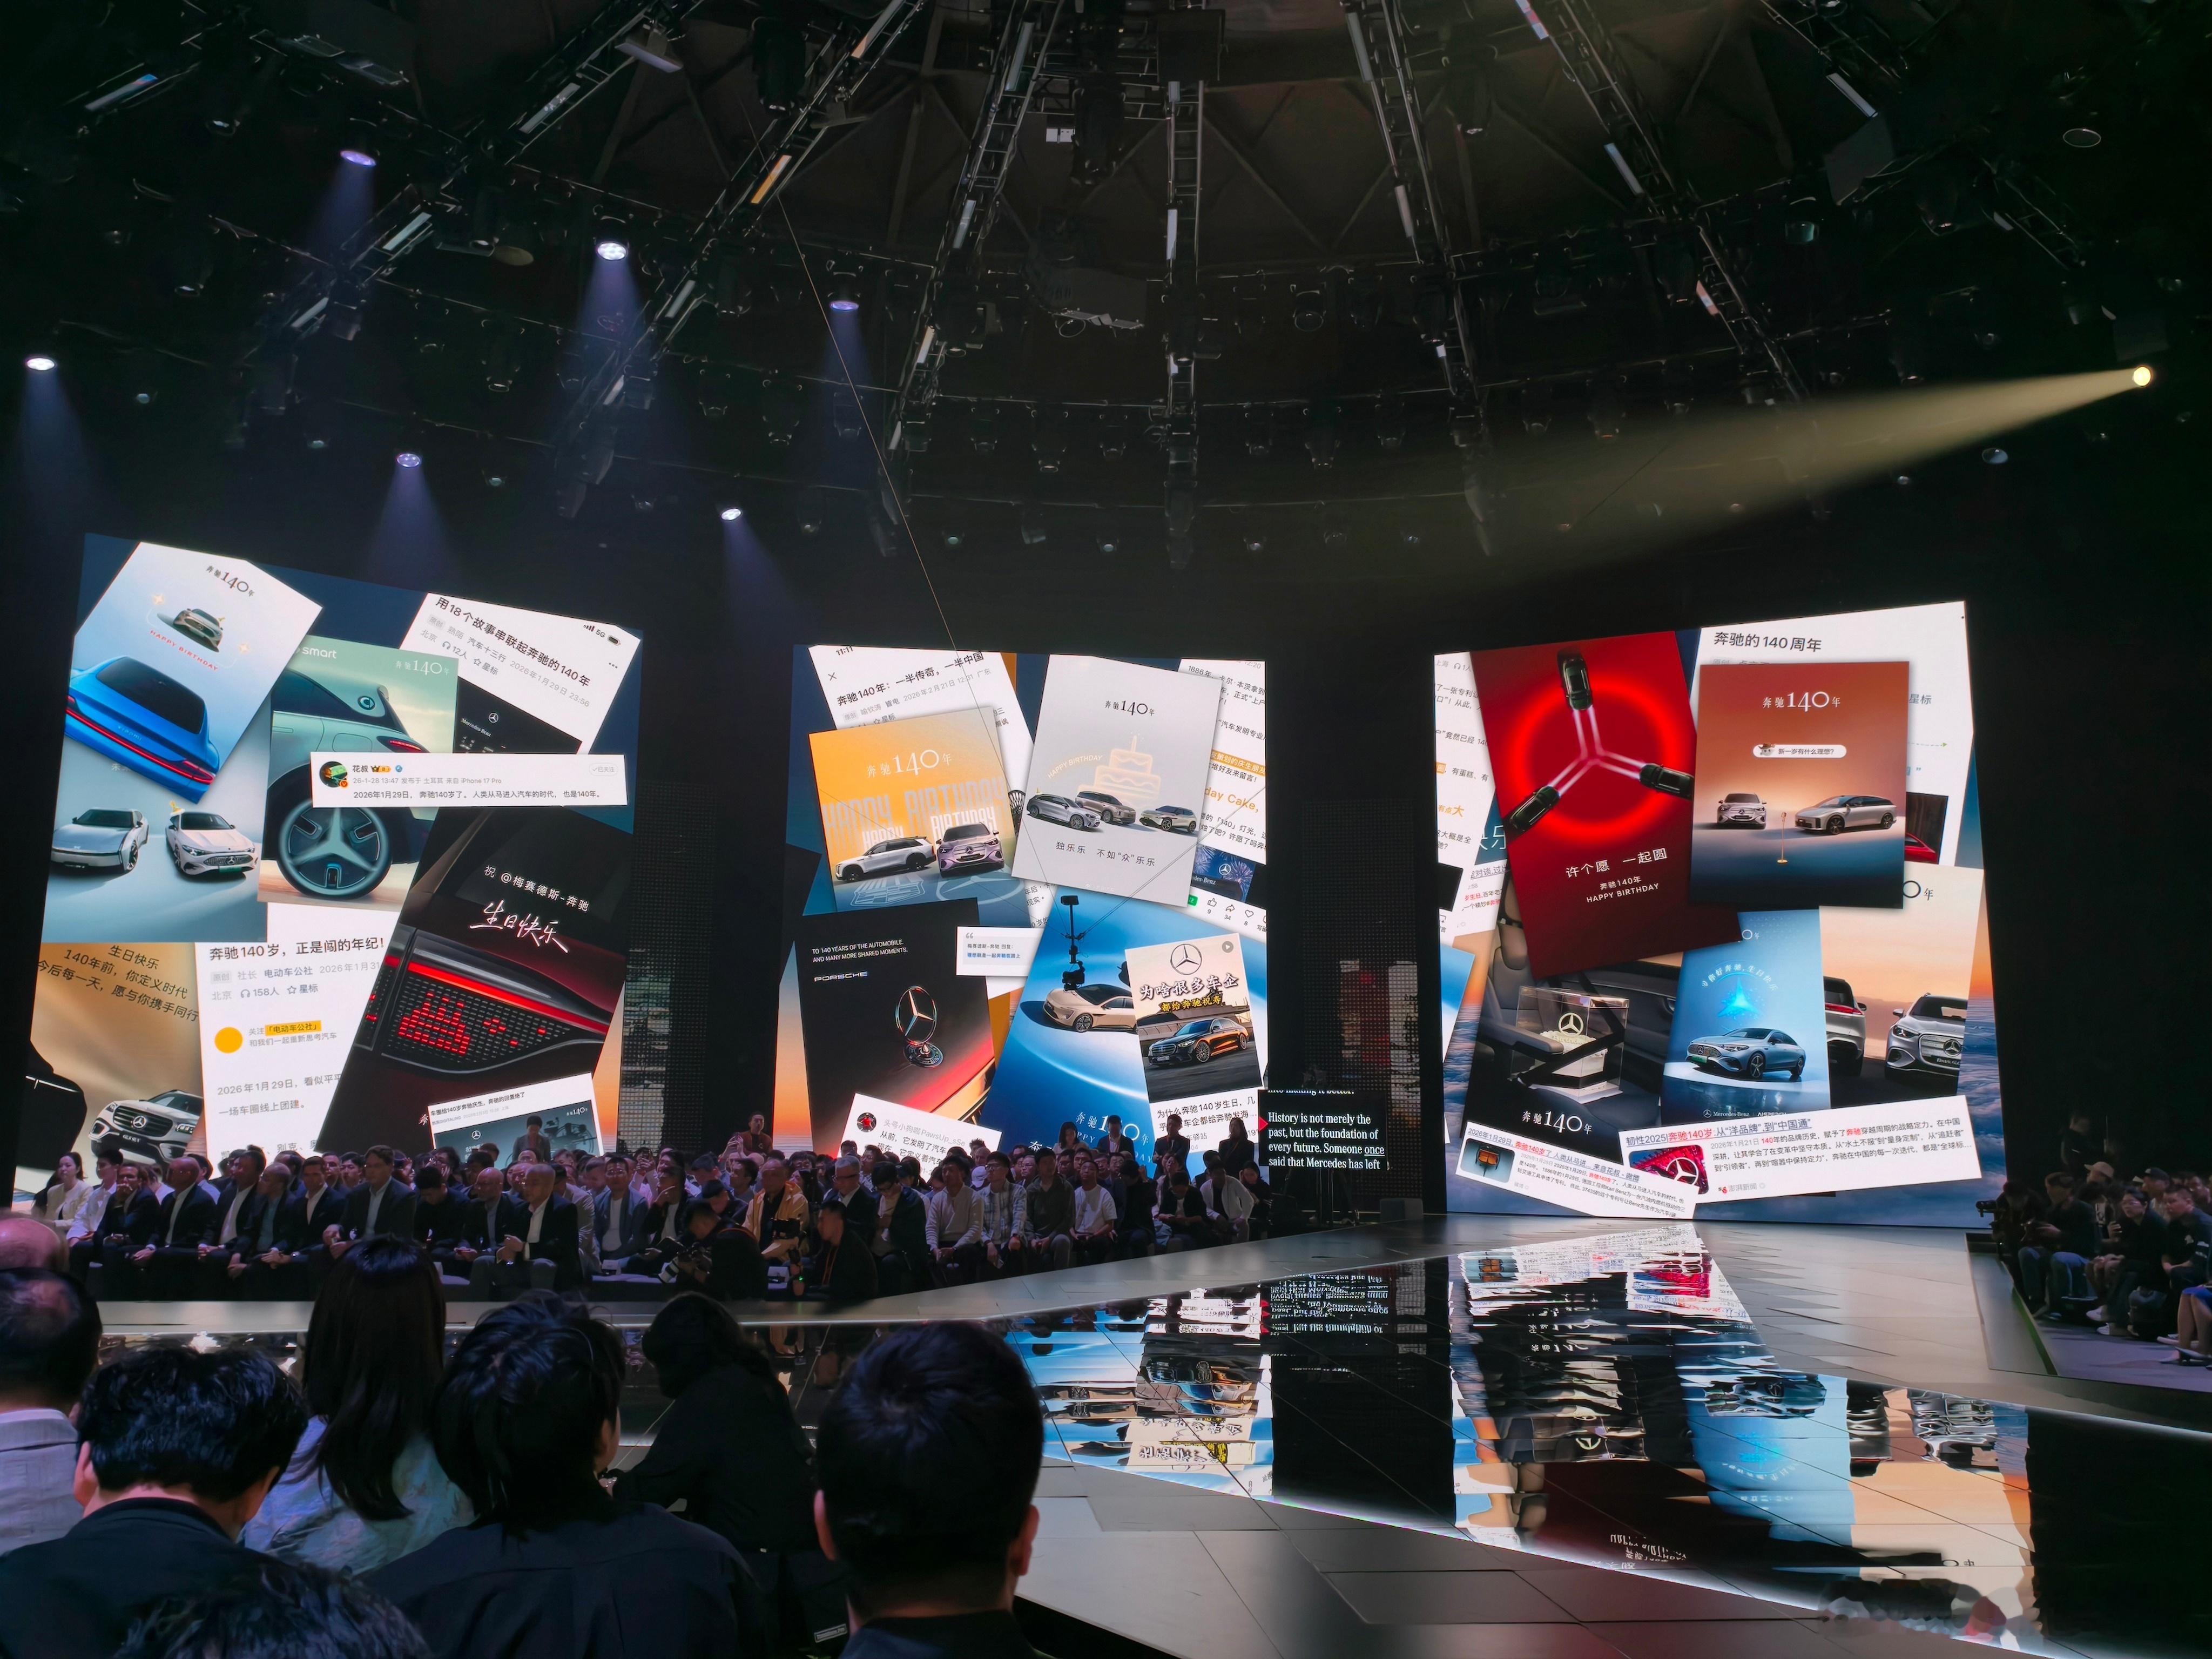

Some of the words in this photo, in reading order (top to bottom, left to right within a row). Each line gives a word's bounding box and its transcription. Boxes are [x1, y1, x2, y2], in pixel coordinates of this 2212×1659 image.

[1713, 631, 1823, 652] 奔驰的140周年
[150, 630, 177, 647] HAPPY
[178, 646, 218, 671] BIRTHDAY
[302, 646, 338, 659] smart
[569, 692, 590, 707] 23:56
[1048, 761, 1068, 779] HAPPY
[1068, 754, 1103, 767] BIRTHDAY
[1227, 794, 1259, 814] Cake,
[1056, 840, 1086, 854] 独乐乐
[1566, 859, 1610, 879] 许个愿
[1622, 847, 1668, 865] 一起圆
[484, 865, 495, 878] 祝
[1586, 892, 1614, 903] HAPPY
[1617, 882, 1660, 897] BIRTHDAY
[469, 900, 569, 954] 生日快乐
[832, 945, 849, 953] YEARS
[858, 949, 880, 958] SHARED
[108, 945, 160, 970] 生日快乐
[814, 970, 868, 982] PORSCHE
[299, 983, 319, 994] 星标
[1139, 973, 1240, 1001] 为啥很多车企
[1268, 1112, 1298, 1124] History
[1300, 1113, 1308, 1123] is
[1310, 1114, 1323, 1123] not
[1325, 1115, 1355, 1126] merely
[1357, 1115, 1371, 1125] the
[1268, 1128, 1289, 1139] past,
[1290, 1128, 1304, 1137] but
[1305, 1128, 1319, 1138] the
[1321, 1128, 1368, 1139] foundation
[1370, 1129, 1379, 1140] of
[1269, 1144, 1291, 1154] every
[1293, 1142, 1322, 1153] future.
[1324, 1143, 1363, 1155] Someone
[1364, 1145, 1385, 1155] once
[1269, 1156, 1285, 1166] said
[1287, 1157, 1305, 1167] that
[1306, 1157, 1346, 1168] Mercedes
[1348, 1158, 1364, 1169] has
[1365, 1158, 1381, 1170] left
